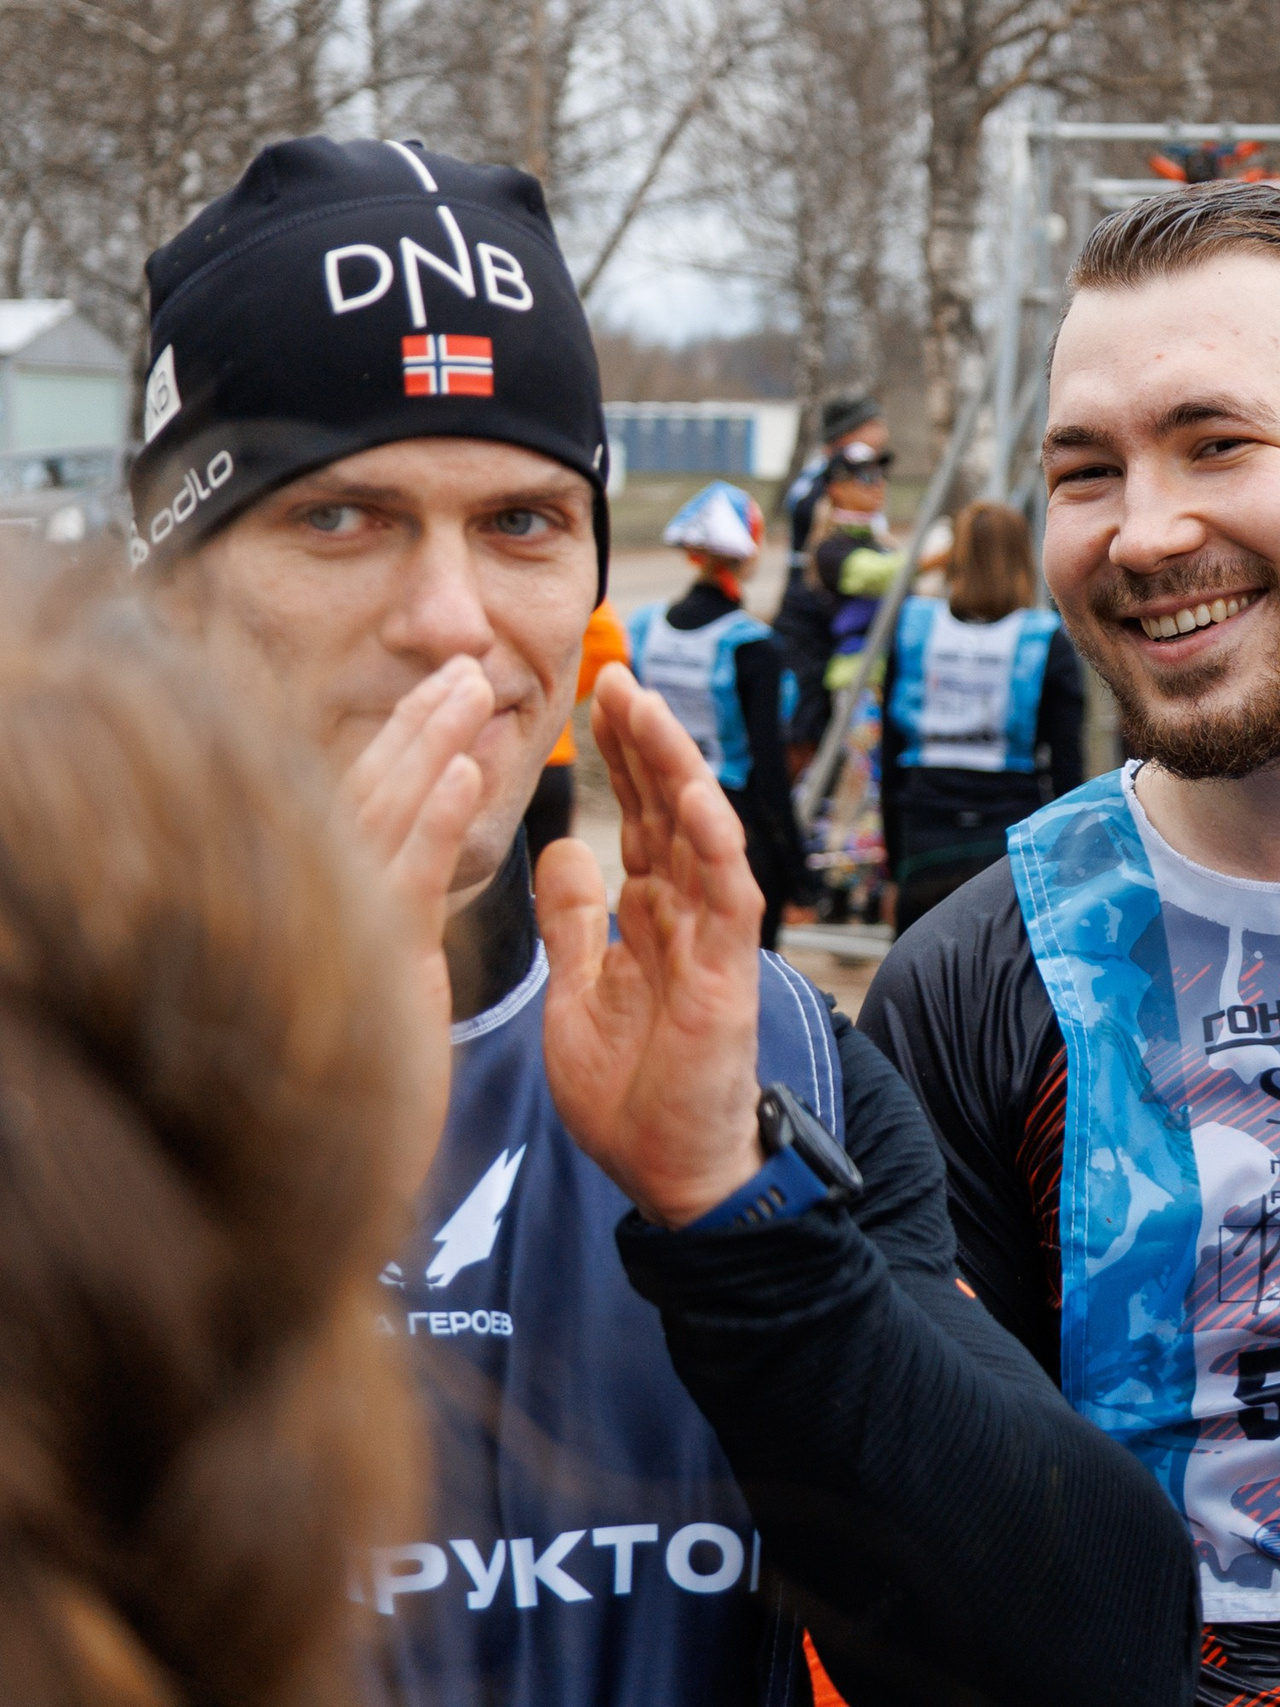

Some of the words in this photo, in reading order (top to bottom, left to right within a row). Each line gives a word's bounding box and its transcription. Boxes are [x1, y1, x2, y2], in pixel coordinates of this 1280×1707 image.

[323, 205, 534, 329] DNB
[151, 449, 234, 544] odlo
[407, 1309, 514, 1336] ГЕРОЕВ
[350, 1522, 762, 1616] РУКТО
